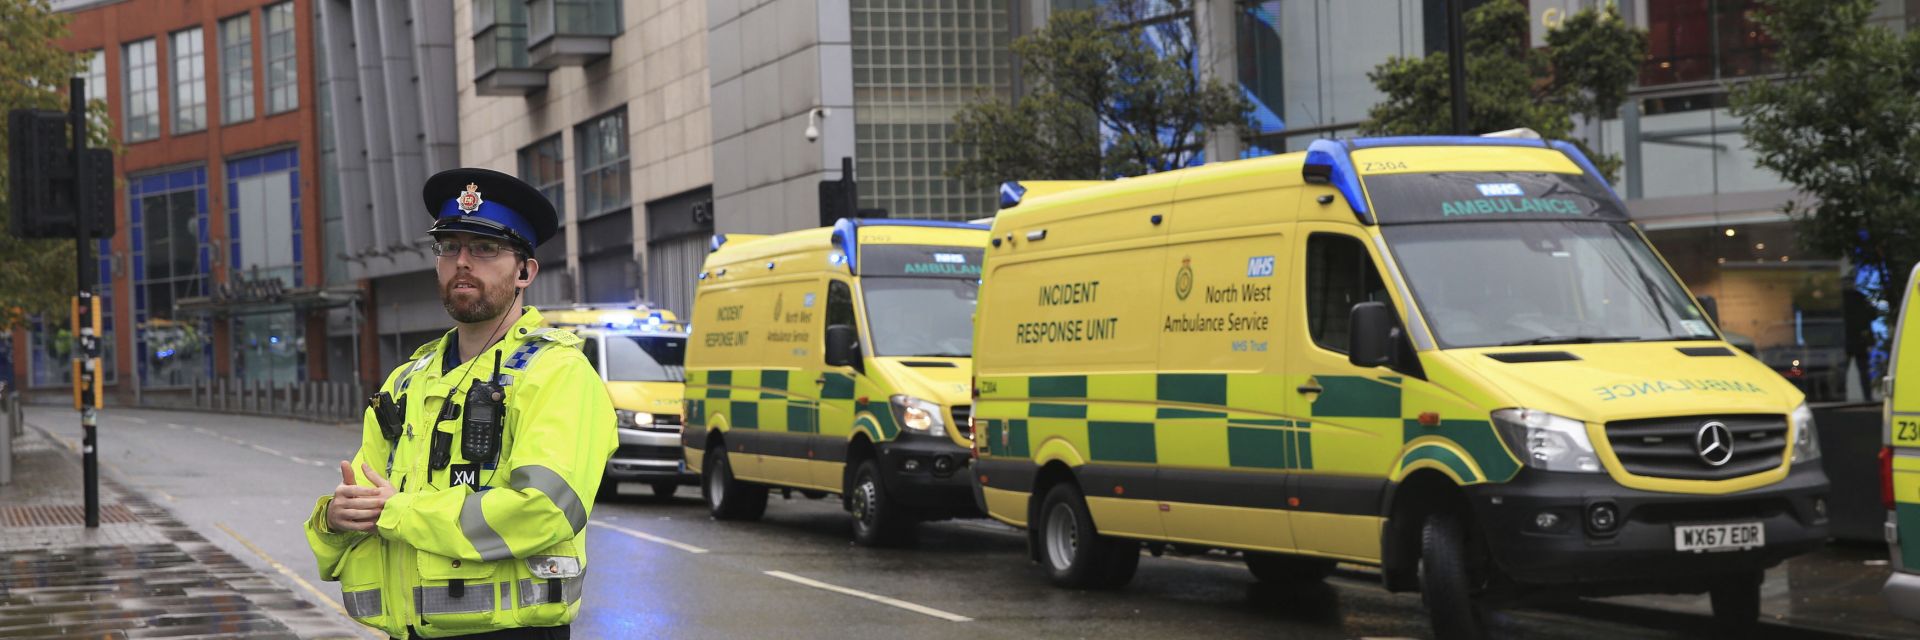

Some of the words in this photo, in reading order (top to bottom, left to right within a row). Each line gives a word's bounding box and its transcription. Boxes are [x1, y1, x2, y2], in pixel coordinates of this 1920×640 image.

[1364, 161, 1408, 171] Z304
[1476, 183, 1524, 196] NHS
[1442, 199, 1582, 216] AMBULANCE
[1248, 256, 1274, 277] NHS
[1039, 281, 1099, 307] INCIDENT
[1205, 284, 1238, 304] North
[1242, 283, 1271, 303] West
[1016, 320, 1083, 344] RESPONSE
[1086, 317, 1118, 341] UNIT
[1163, 313, 1225, 333] Ambulance
[1227, 311, 1269, 332] Service
[1897, 420, 1920, 441] Z3
[453, 470, 476, 486] XM
[1682, 527, 1727, 546] WX67
[1730, 525, 1759, 545] EDR
